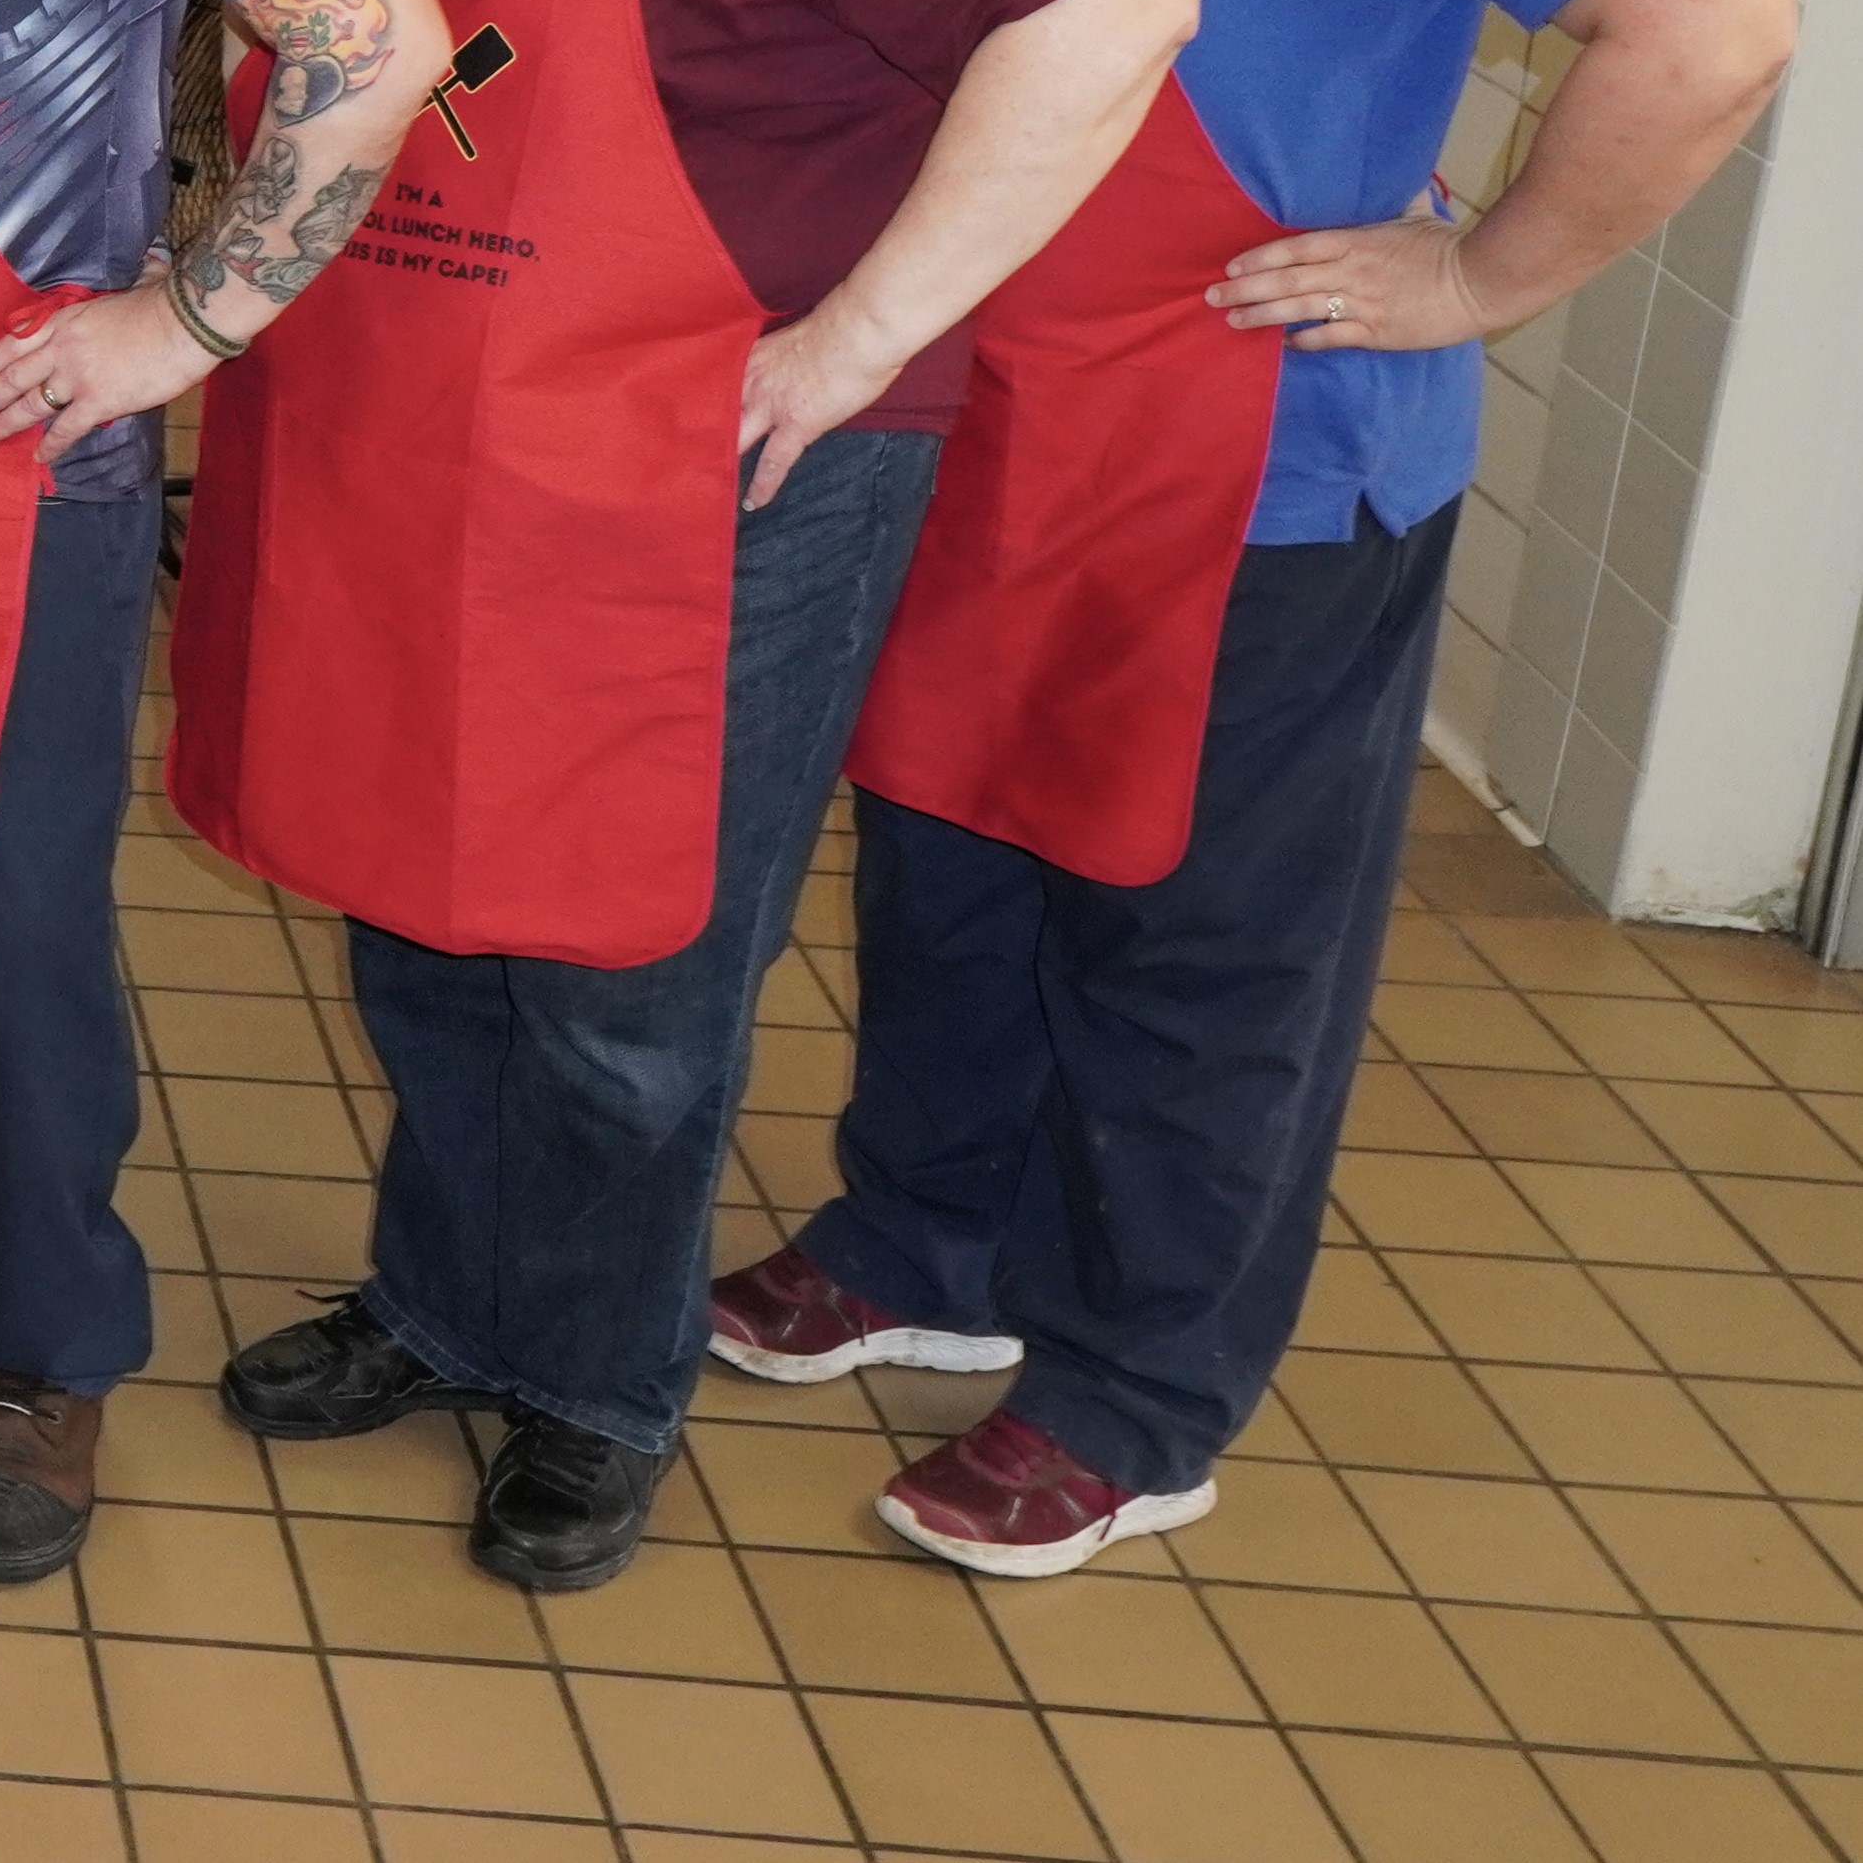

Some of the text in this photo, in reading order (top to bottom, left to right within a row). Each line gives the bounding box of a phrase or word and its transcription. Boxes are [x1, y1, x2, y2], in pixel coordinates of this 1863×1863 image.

[395, 183, 443, 208] I'M A
[391, 215, 463, 246] LUNCH
[468, 229, 541, 262] HERO.
[343, 240, 510, 288] HIS IS MY CAPE!
